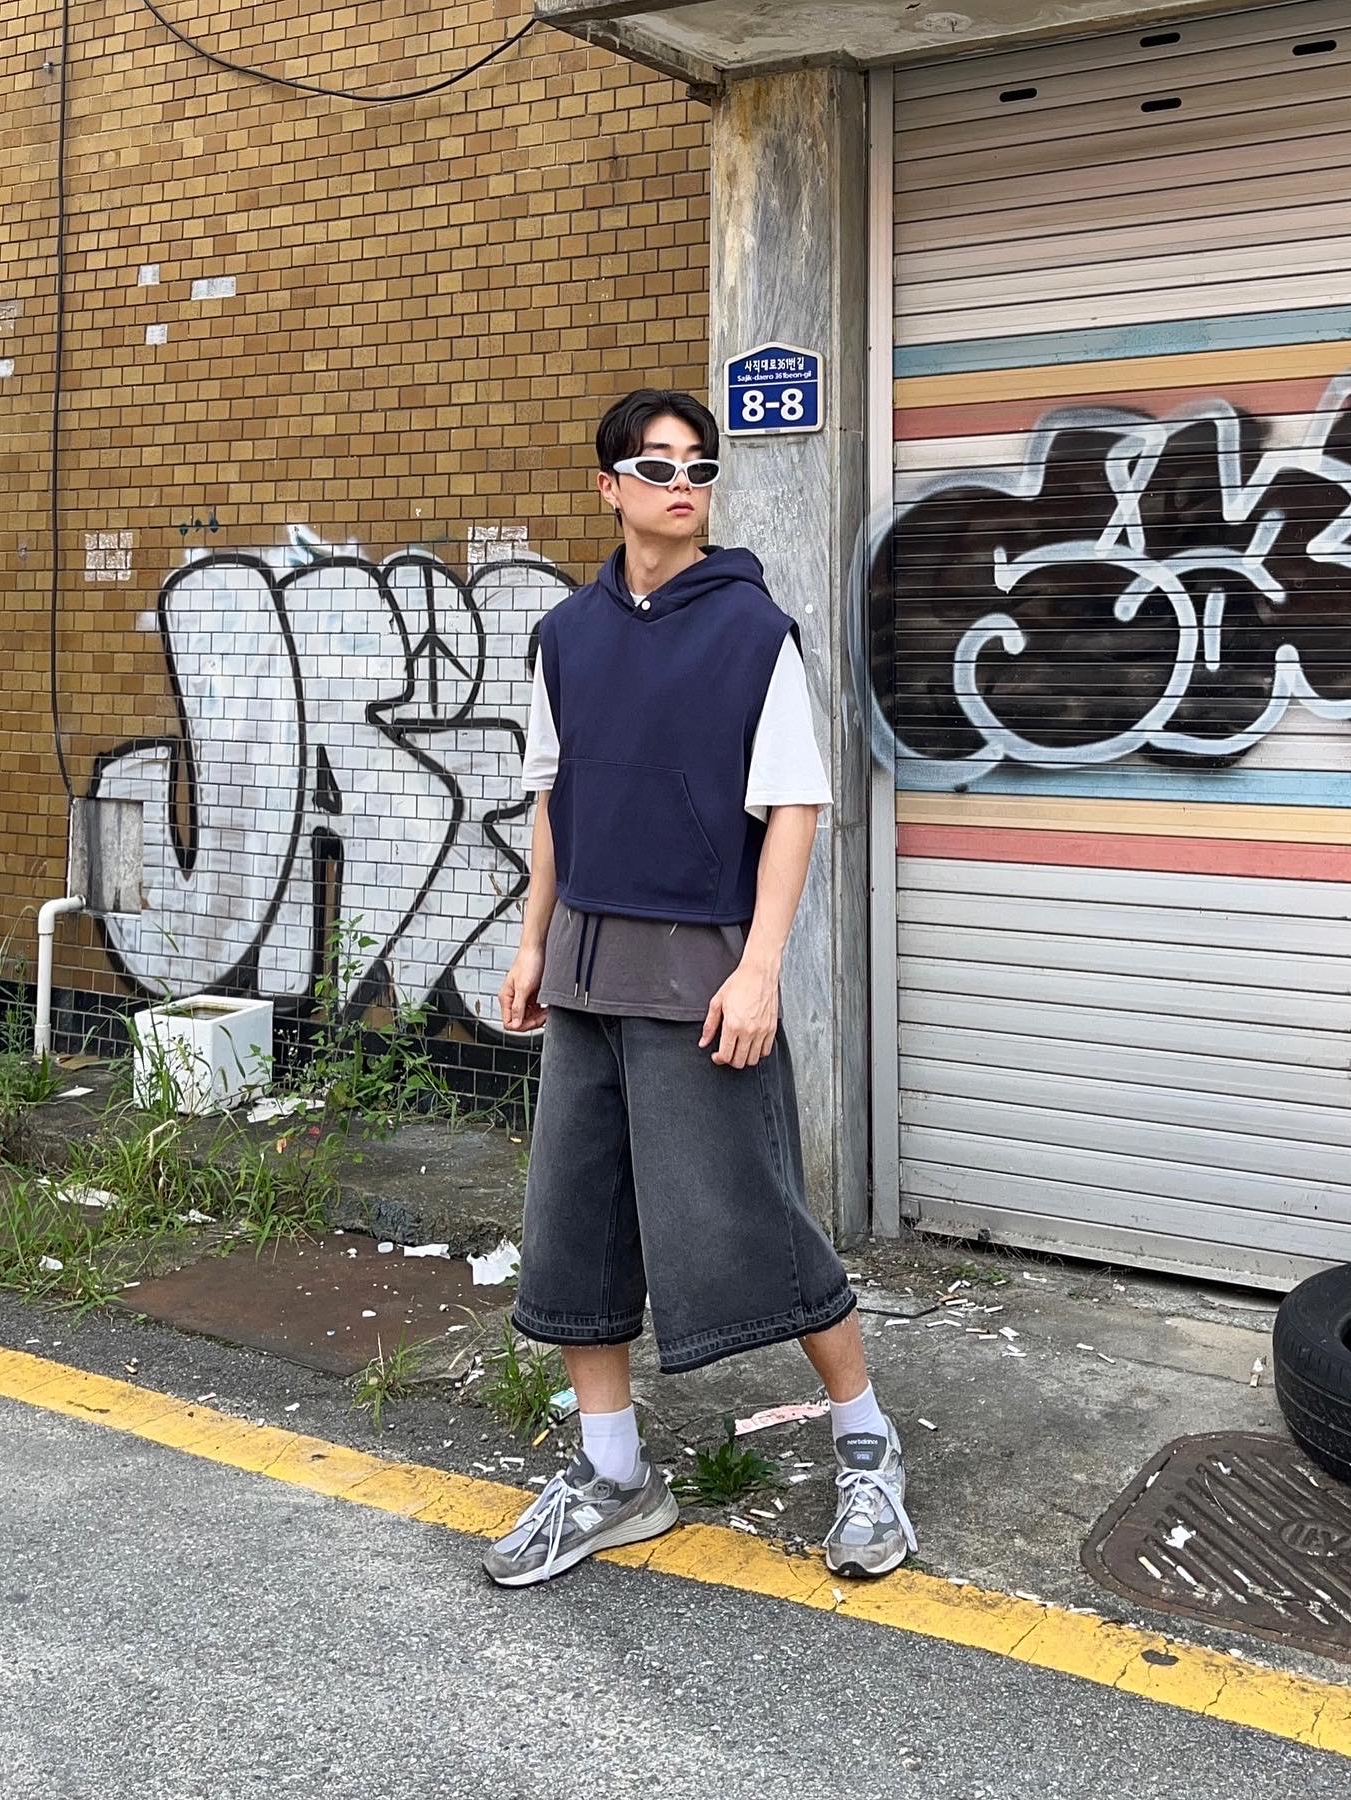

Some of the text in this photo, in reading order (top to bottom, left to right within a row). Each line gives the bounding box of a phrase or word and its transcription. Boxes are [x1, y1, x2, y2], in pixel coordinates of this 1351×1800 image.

[744, 357, 805, 373] 사직대로361번길
[737, 373, 774, 382] Sajik-daero
[741, 388, 804, 423] 8-8
